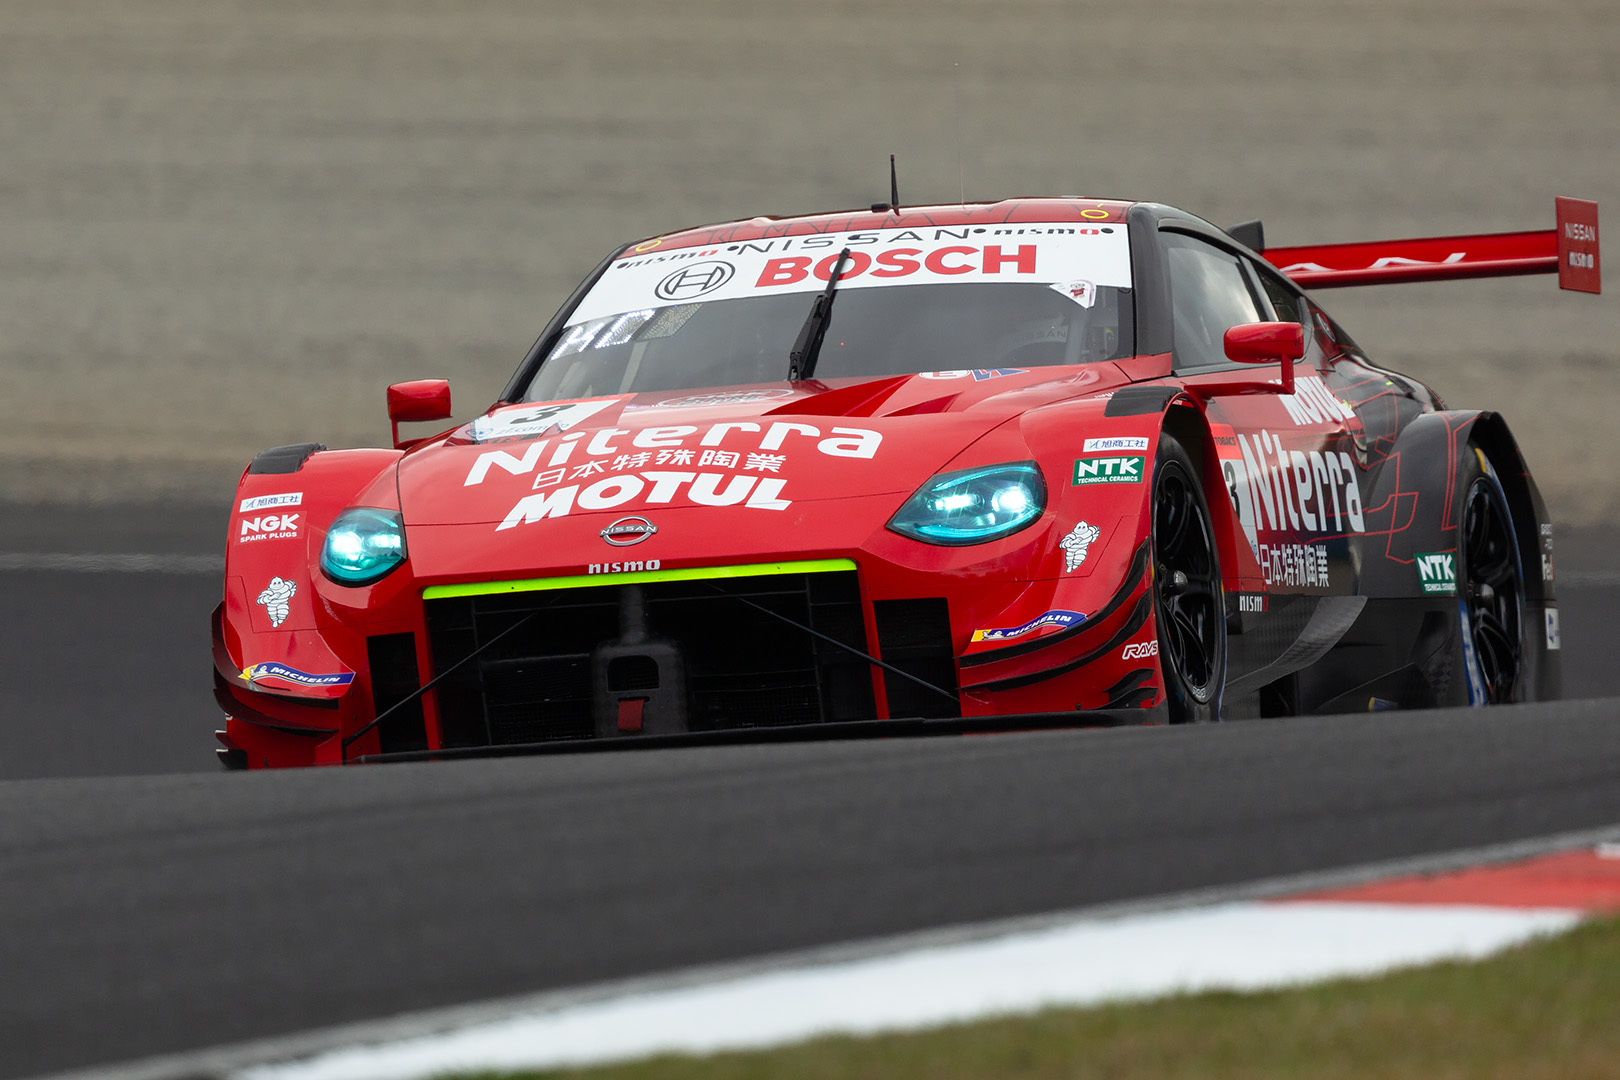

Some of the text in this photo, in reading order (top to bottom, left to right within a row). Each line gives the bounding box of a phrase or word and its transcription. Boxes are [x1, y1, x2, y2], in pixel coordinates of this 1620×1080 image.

[737, 228, 970, 256] NISSAN
[993, 228, 1100, 236] nismo
[1565, 222, 1596, 242] NISSAN
[755, 244, 1037, 288] BOSCH
[1267, 375, 1357, 426] MOTUL
[509, 403, 578, 425] 3
[463, 421, 884, 487] Niterra
[531, 449, 787, 490] 日本特殊陶業
[1078, 457, 1140, 477] NTK
[1077, 475, 1139, 485] TECHNICAL CERAMICS
[1223, 461, 1241, 521] 3
[1237, 428, 1366, 533] Niterra
[494, 470, 793, 532] MOTUL
[241, 513, 300, 536] NGK
[600, 524, 658, 536] NISSAN
[239, 531, 298, 543] SPARK PLUGS
[588, 559, 661, 575] nismo
[1259, 543, 1330, 588] 日本特殊陶業
[1416, 554, 1455, 581] NTK
[1239, 595, 1269, 612] nismo
[1006, 613, 1073, 638] MICHELIN
[1121, 639, 1159, 661] RAYS
[270, 666, 341, 683] MICHELIN
